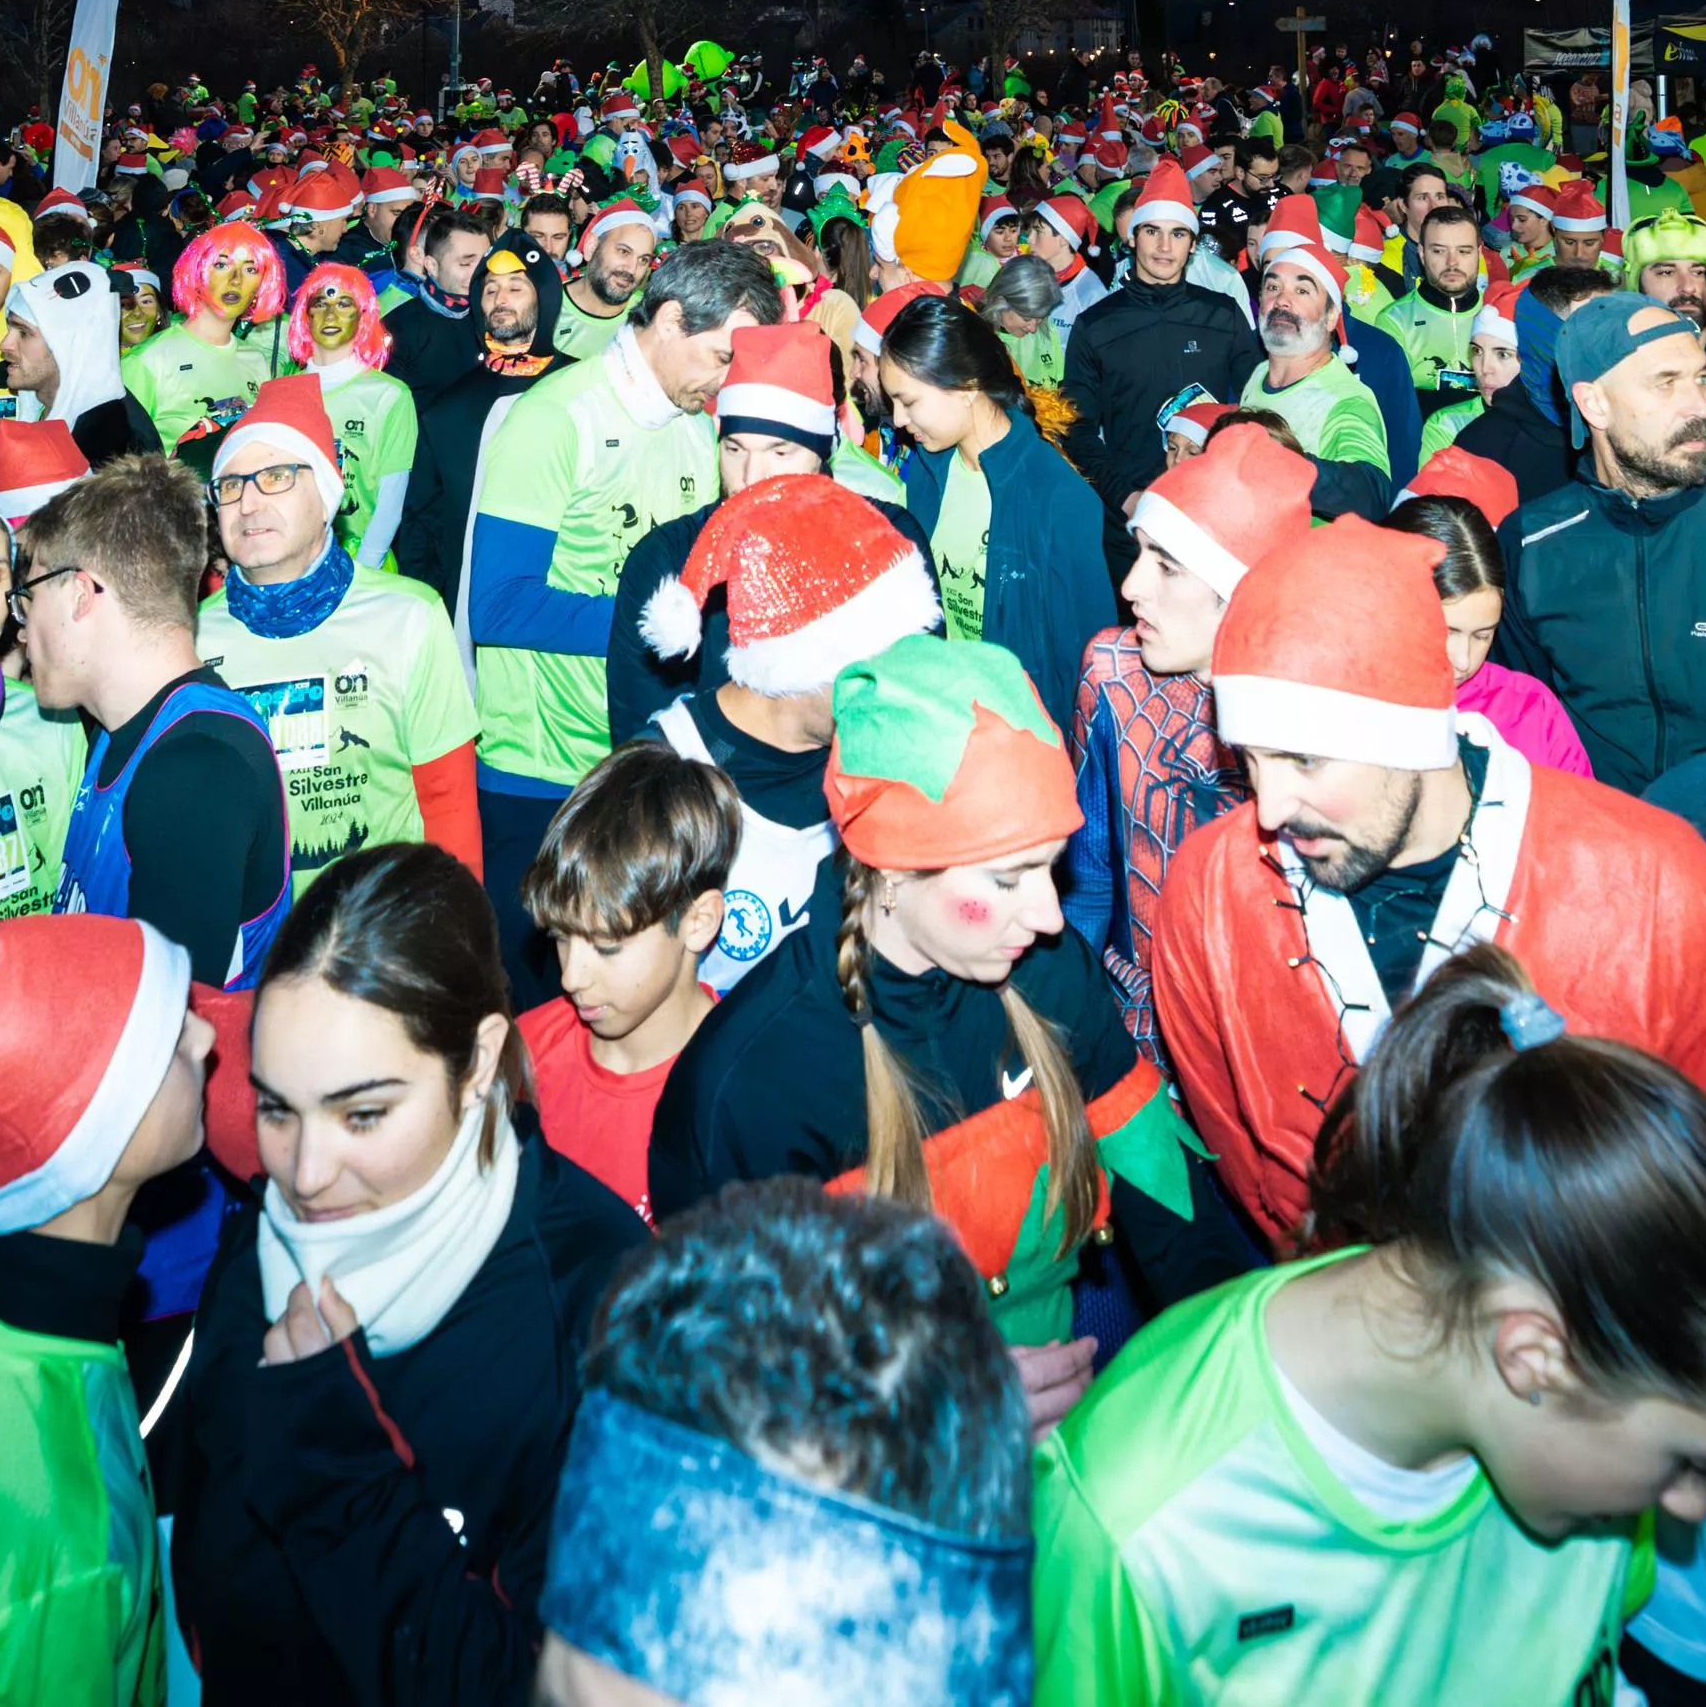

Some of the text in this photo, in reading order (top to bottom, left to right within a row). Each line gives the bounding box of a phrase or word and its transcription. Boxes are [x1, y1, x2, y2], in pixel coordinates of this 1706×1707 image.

[344, 419, 364, 432] on
[679, 476, 695, 492] on
[946, 596, 983, 622] Silvestr
[957, 592, 974, 608] San
[334, 673, 368, 695] on
[335, 694, 368, 705] Villanúa
[313, 765, 342, 779] San
[289, 772, 368, 797] Silvestre
[19, 784, 45, 811] on
[301, 793, 361, 813] Villanúa
[11, 886, 39, 905] San
